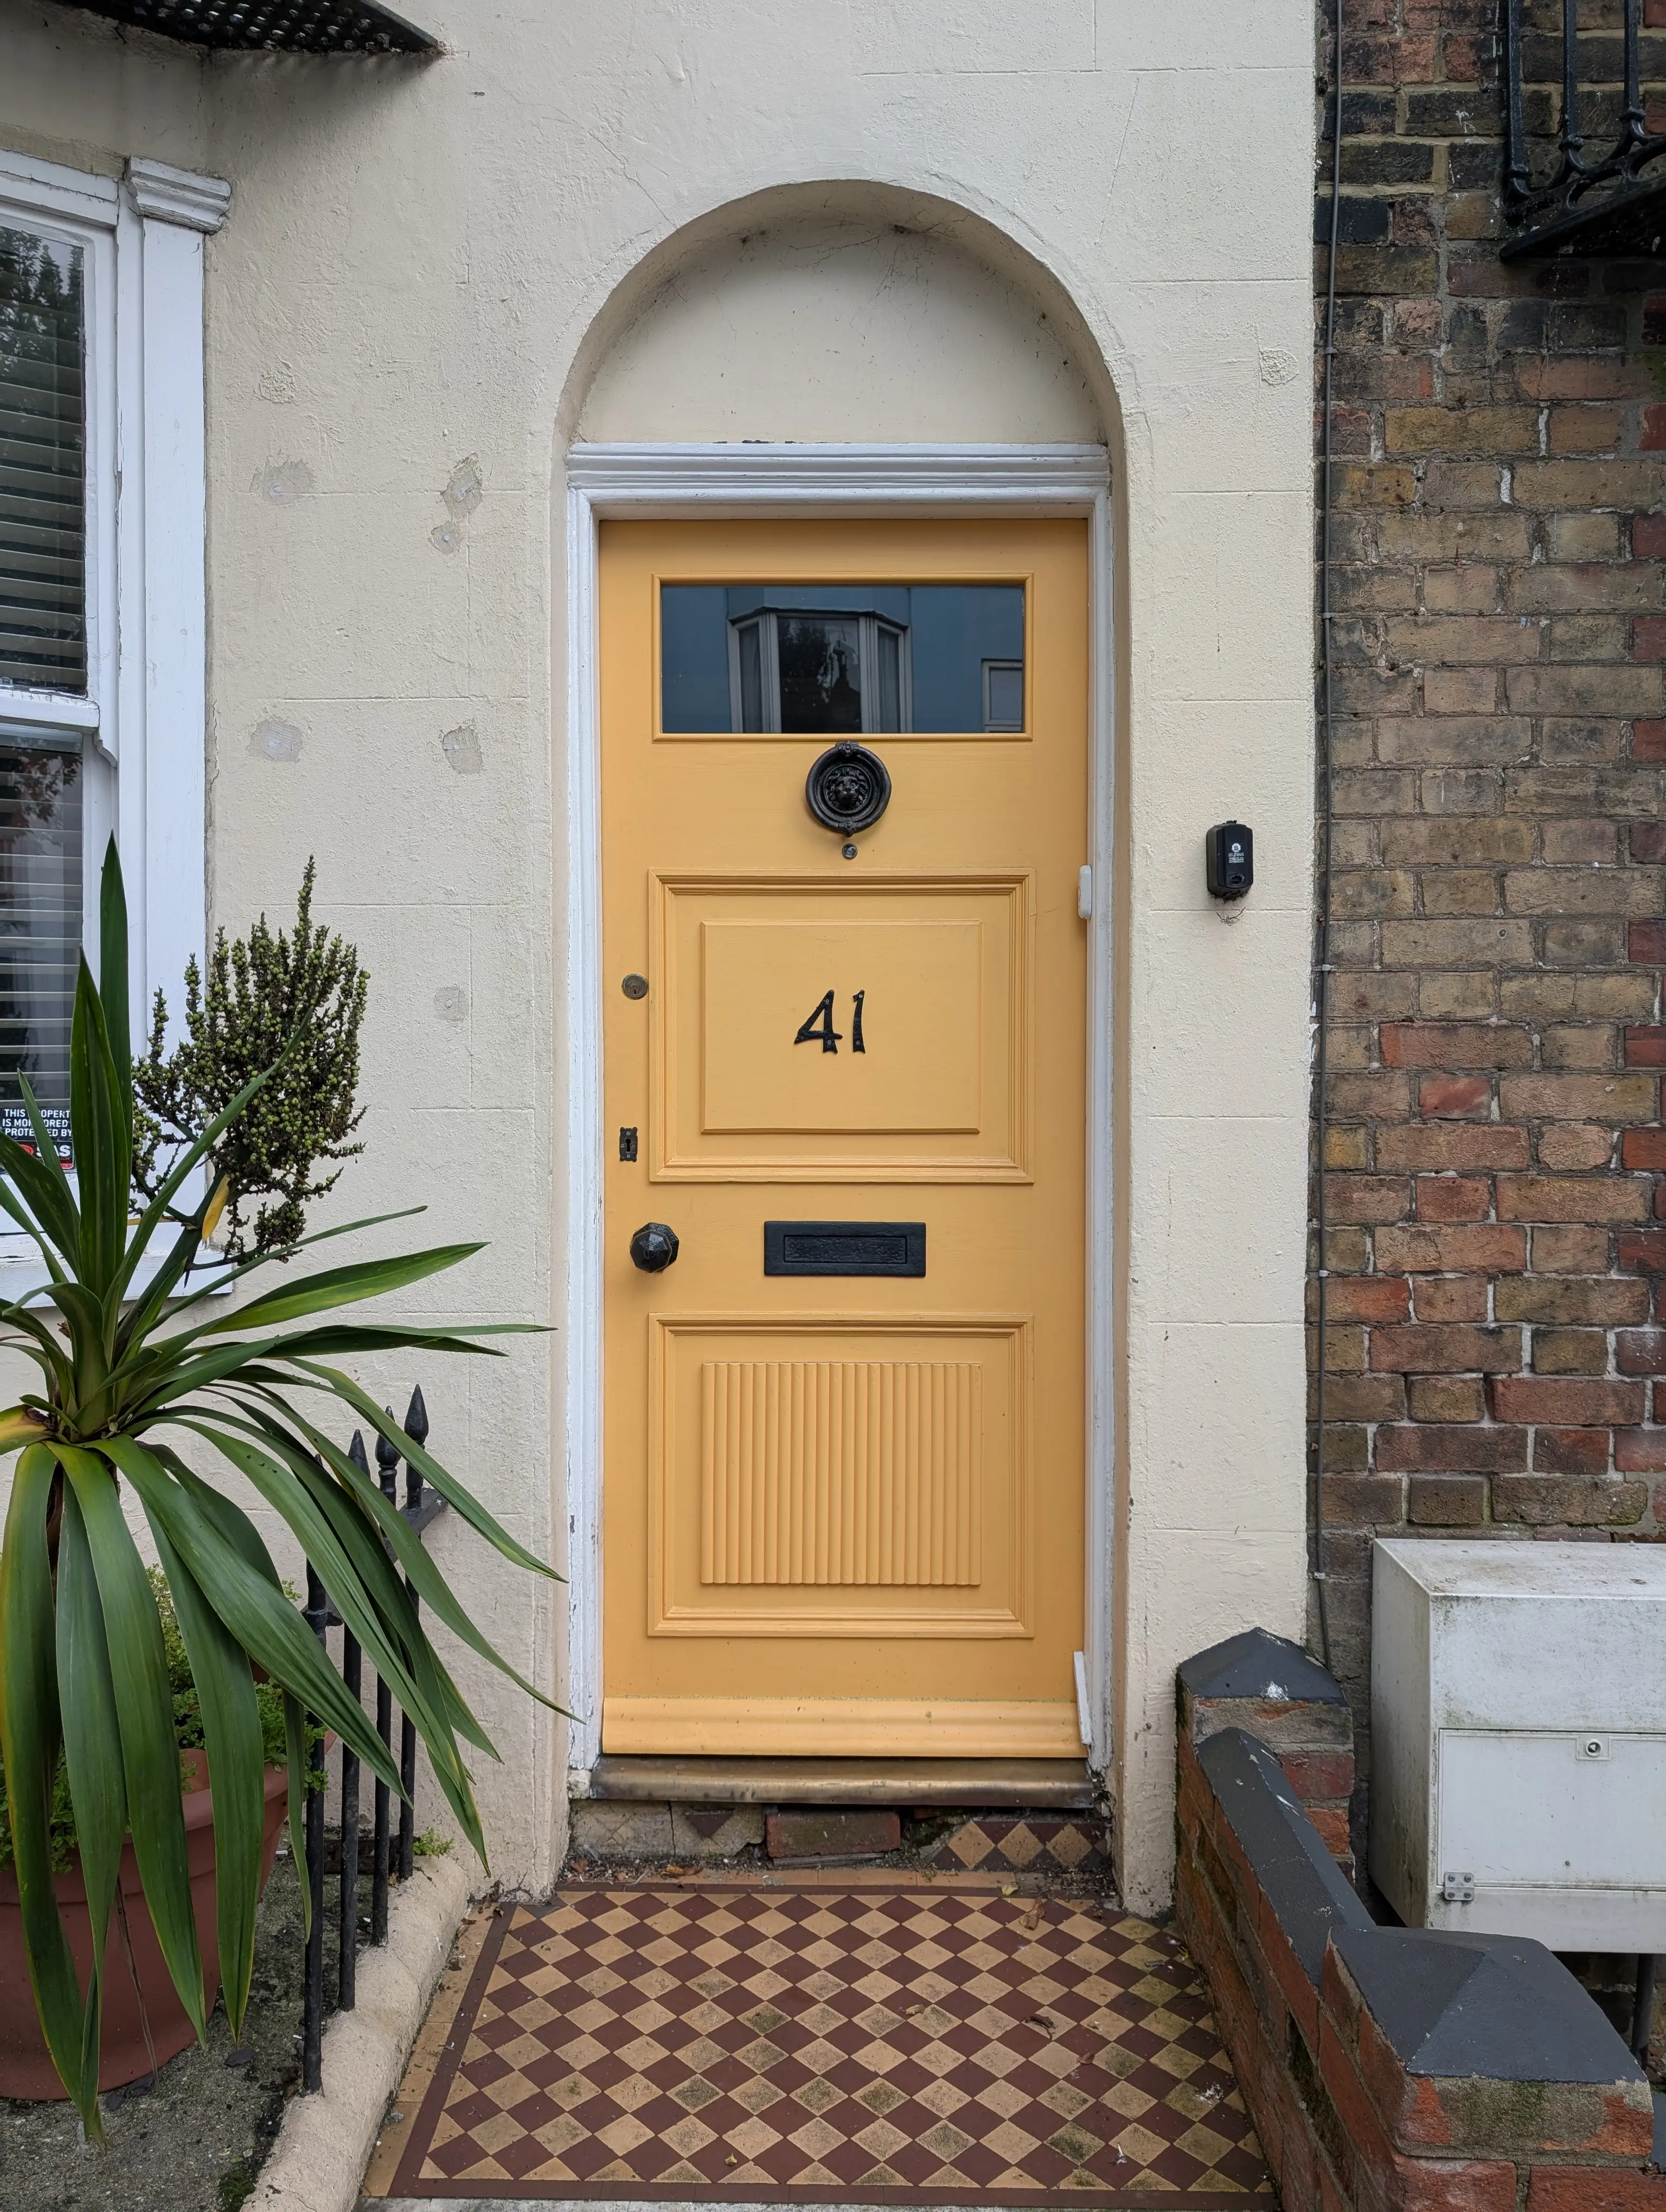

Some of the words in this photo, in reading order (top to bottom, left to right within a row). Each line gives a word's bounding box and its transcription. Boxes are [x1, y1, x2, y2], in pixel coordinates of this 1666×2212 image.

[793, 989, 866, 1054] 41
[4, 1109, 25, 1117] THIS
[39, 1109, 71, 1118] OPERT
[2, 1118, 11, 1127] IS
[14, 1119, 68, 1128] MOORED
[5, 1128, 58, 1137] PROTEED
[61, 1129, 72, 1137] BY
